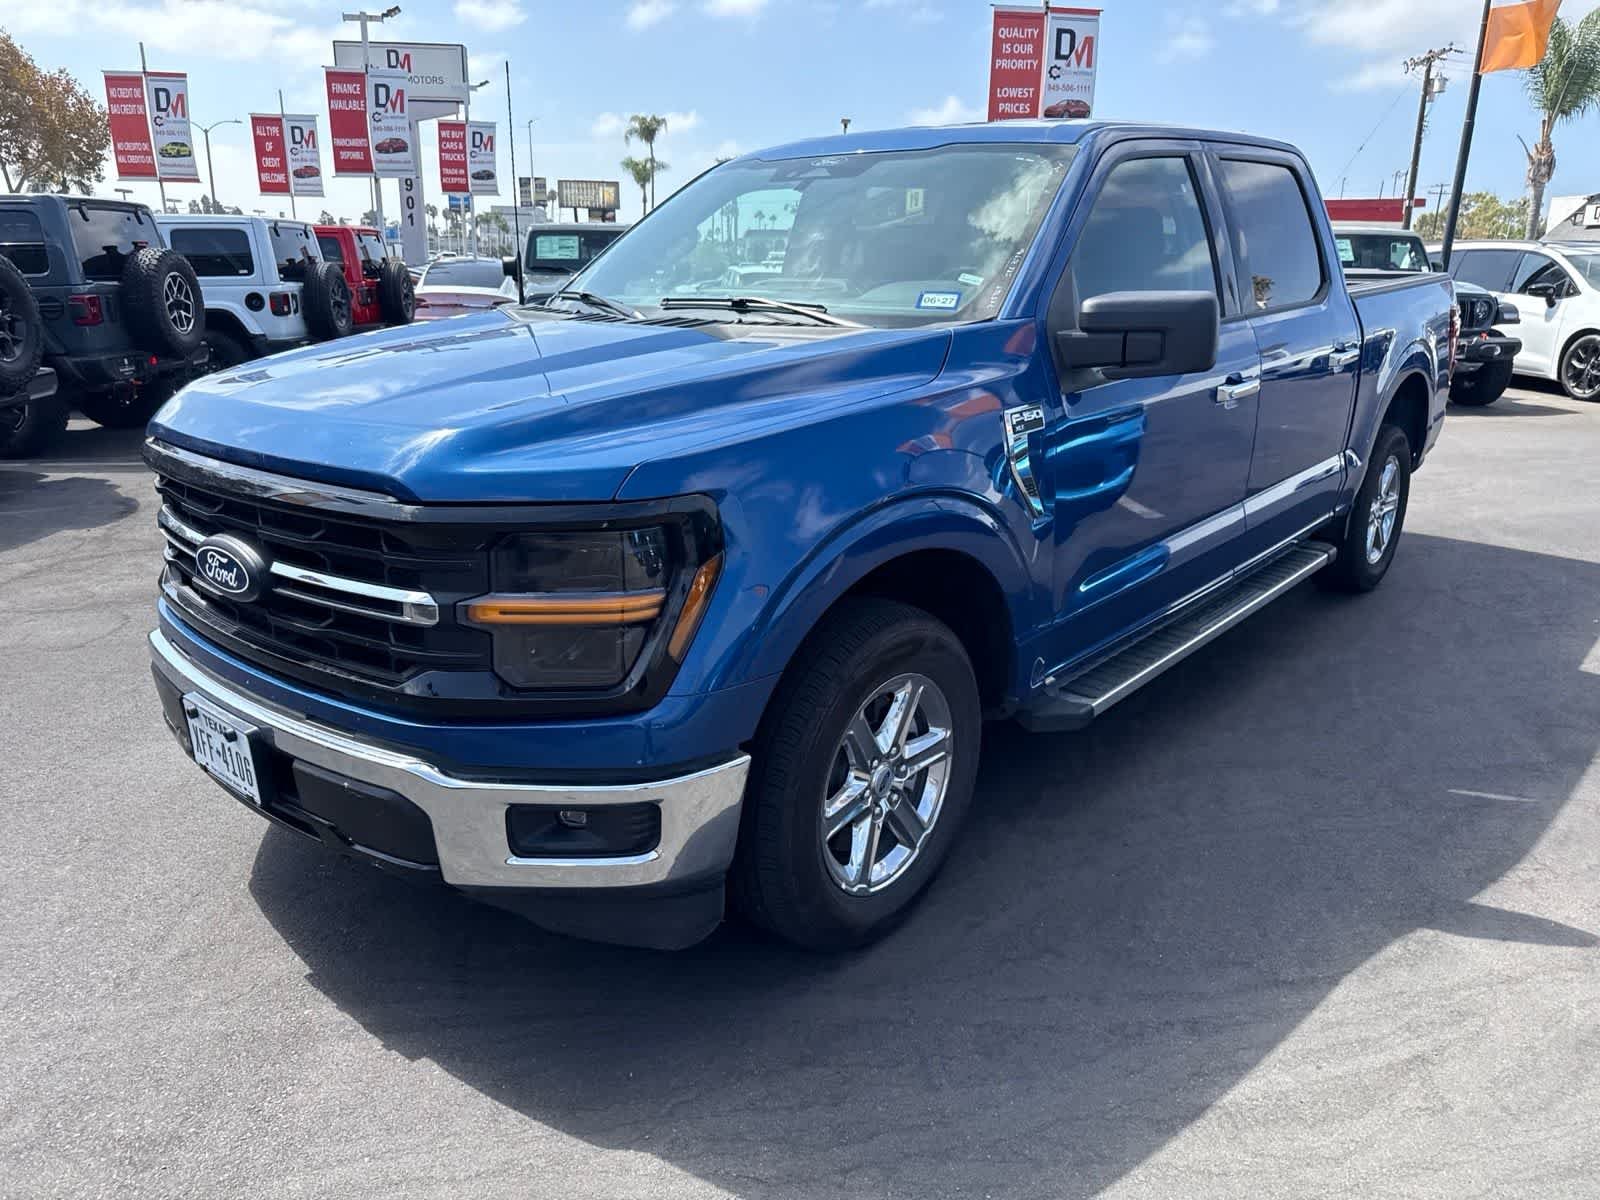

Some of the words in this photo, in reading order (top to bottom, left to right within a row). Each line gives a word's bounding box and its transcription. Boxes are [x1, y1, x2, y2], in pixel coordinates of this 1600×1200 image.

[998, 27, 1039, 39] QUALITY
[1002, 43, 1012, 53] IS
[1013, 44, 1034, 54] OUR
[995, 59, 1039, 69] PRIORITY
[331, 83, 361, 95] FINANCE
[996, 87, 1035, 98] LOWEST
[330, 99, 366, 111] AVAILABLE
[998, 103, 1031, 114] PRICES
[256, 125, 267, 137] ALL
[267, 126, 280, 137] TYPE
[440, 130, 451, 138] WE
[265, 142, 273, 152] OF
[441, 142, 458, 150] CARS
[441, 152, 465, 161] TRUCKS
[262, 157, 280, 168] CREDIT
[260, 173, 287, 184] WELCOME
[1011, 409, 1043, 425] F-150
[205, 551, 239, 588] Ford
